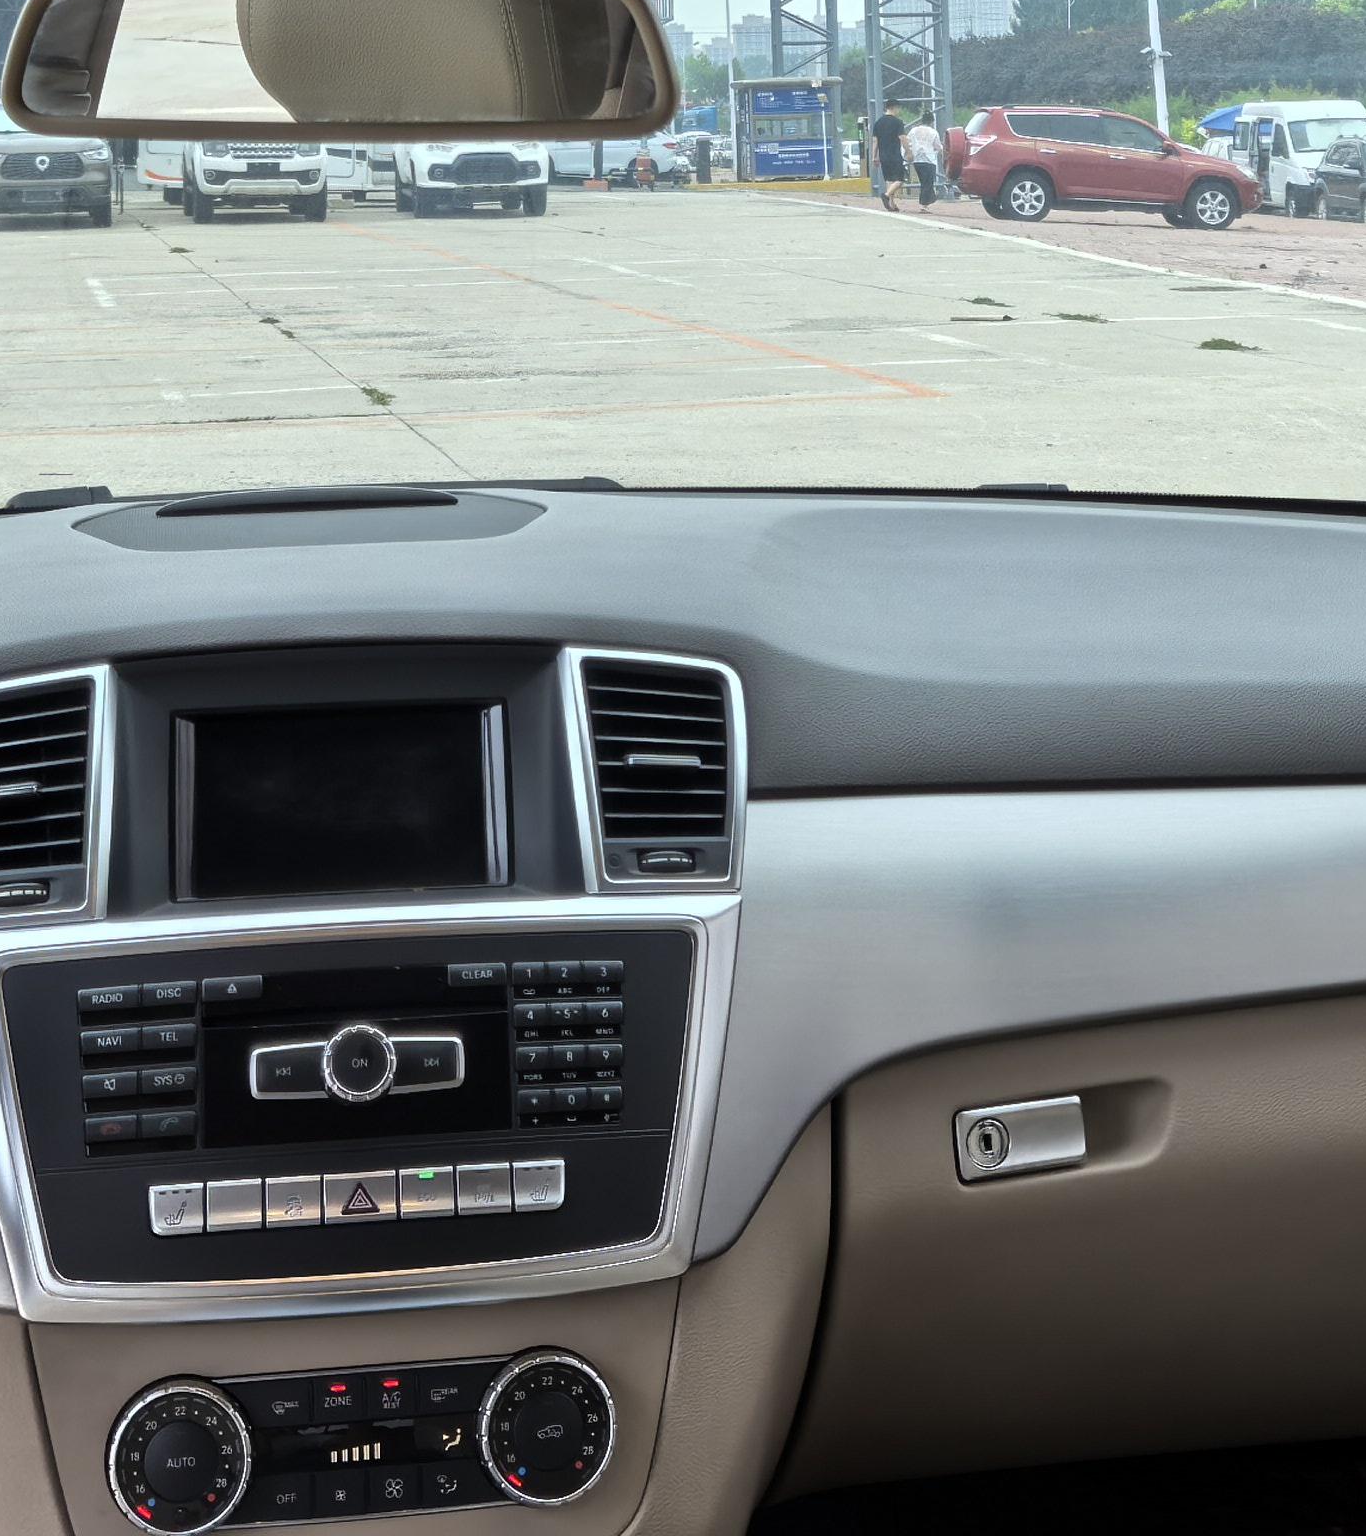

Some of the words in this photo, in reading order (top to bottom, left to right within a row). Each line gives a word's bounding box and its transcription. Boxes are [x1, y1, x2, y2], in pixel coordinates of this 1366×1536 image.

[462, 969, 493, 979] CLEAR
[561, 968, 568, 978] 2
[600, 967, 608, 977] 3
[156, 987, 182, 999] DISC
[92, 993, 123, 1004] RADIO
[527, 1010, 534, 1020] 4
[564, 1009, 571, 1019] 5
[602, 1008, 609, 1018] 6
[97, 1036, 122, 1047] NAVI
[160, 1032, 178, 1042] TEL
[529, 1053, 536, 1063] 7
[566, 1052, 573, 1062] 8
[602, 1050, 609, 1060] 9
[351, 1058, 368, 1068] ON
[153, 1075, 173, 1086] SYS
[568, 1095, 575, 1105] 0
[542, 1376, 553, 1385] 22
[514, 1391, 525, 1400] 20
[324, 1396, 352, 1407] ZONE
[175, 1406, 186, 1416] 22
[206, 1416, 217, 1426] 24
[587, 1414, 598, 1423] 26
[145, 1421, 157, 1431] 20
[501, 1422, 509, 1431] 18
[221, 1445, 233, 1455] 26
[583, 1446, 594, 1455] 28
[130, 1452, 140, 1461] 18
[507, 1454, 516, 1463] 16
[166, 1457, 196, 1468] AUTO
[216, 1478, 227, 1488] 28
[135, 1484, 146, 1494] 16
[276, 1493, 297, 1504] OFF
